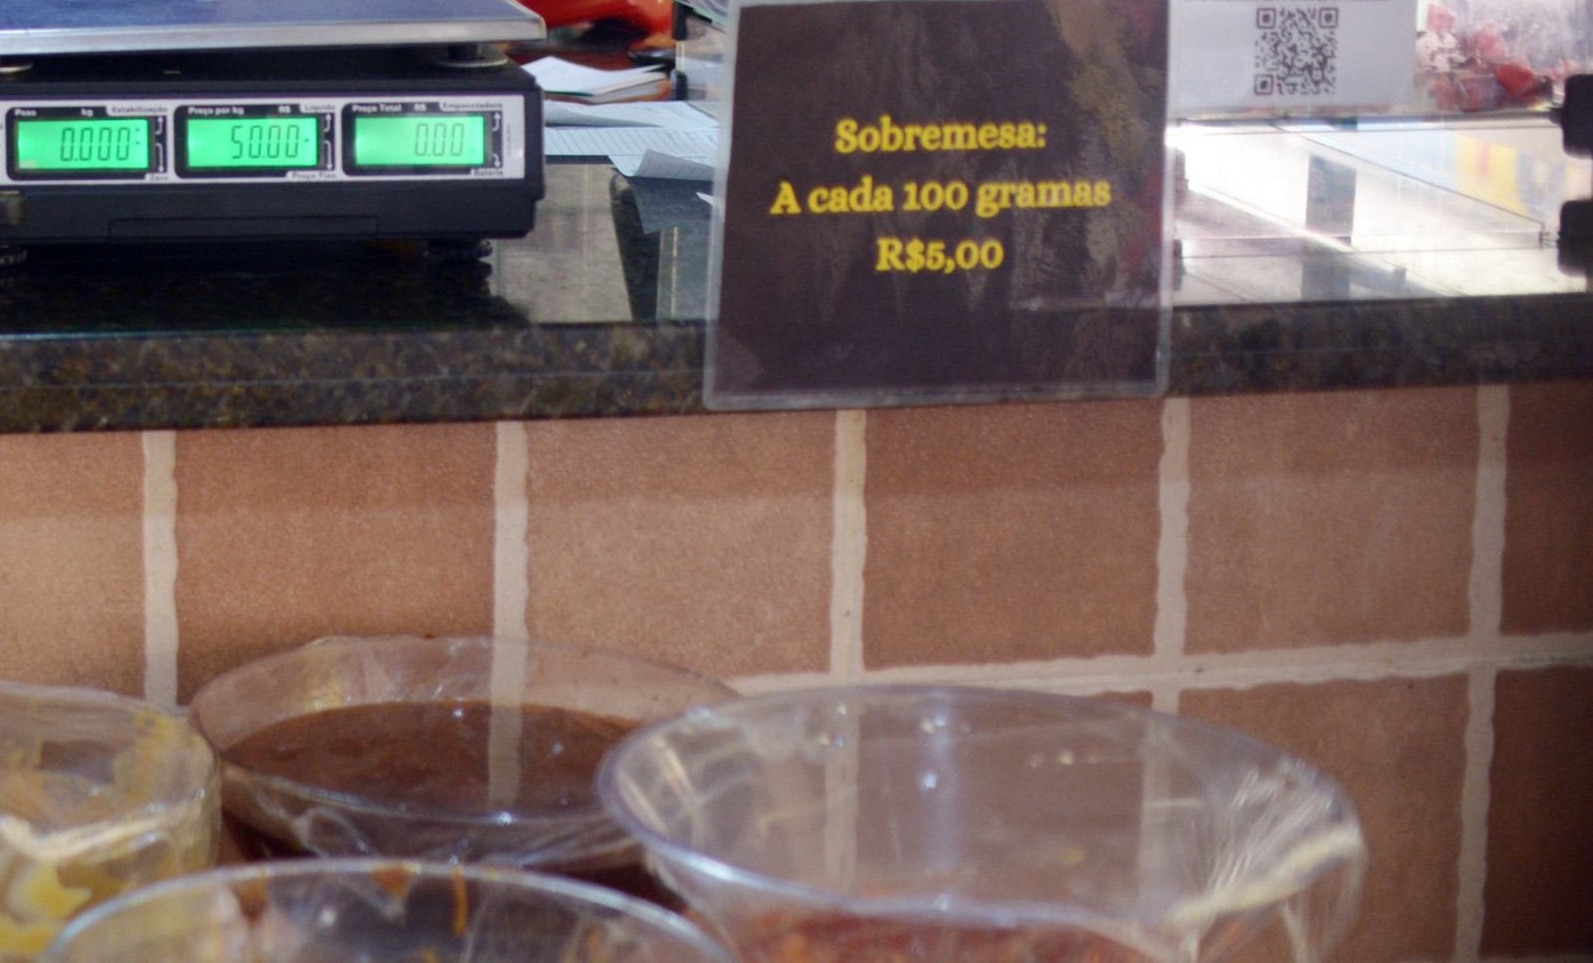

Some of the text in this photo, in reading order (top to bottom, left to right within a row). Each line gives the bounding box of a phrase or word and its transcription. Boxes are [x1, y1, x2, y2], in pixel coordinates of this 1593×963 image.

[14, 108, 93, 117] Peso kg
[187, 106, 214, 116] Preço
[232, 106, 245, 116] kg
[352, 103, 402, 114] Preço Total
[59, 126, 132, 162] 0.000
[230, 124, 300, 159] 50.00
[413, 122, 466, 157] 0.00
[834, 115, 1047, 154] Sobremesa:
[769, 176, 1112, 217] A cada 100 gramas
[875, 237, 1005, 275] R$5,00
